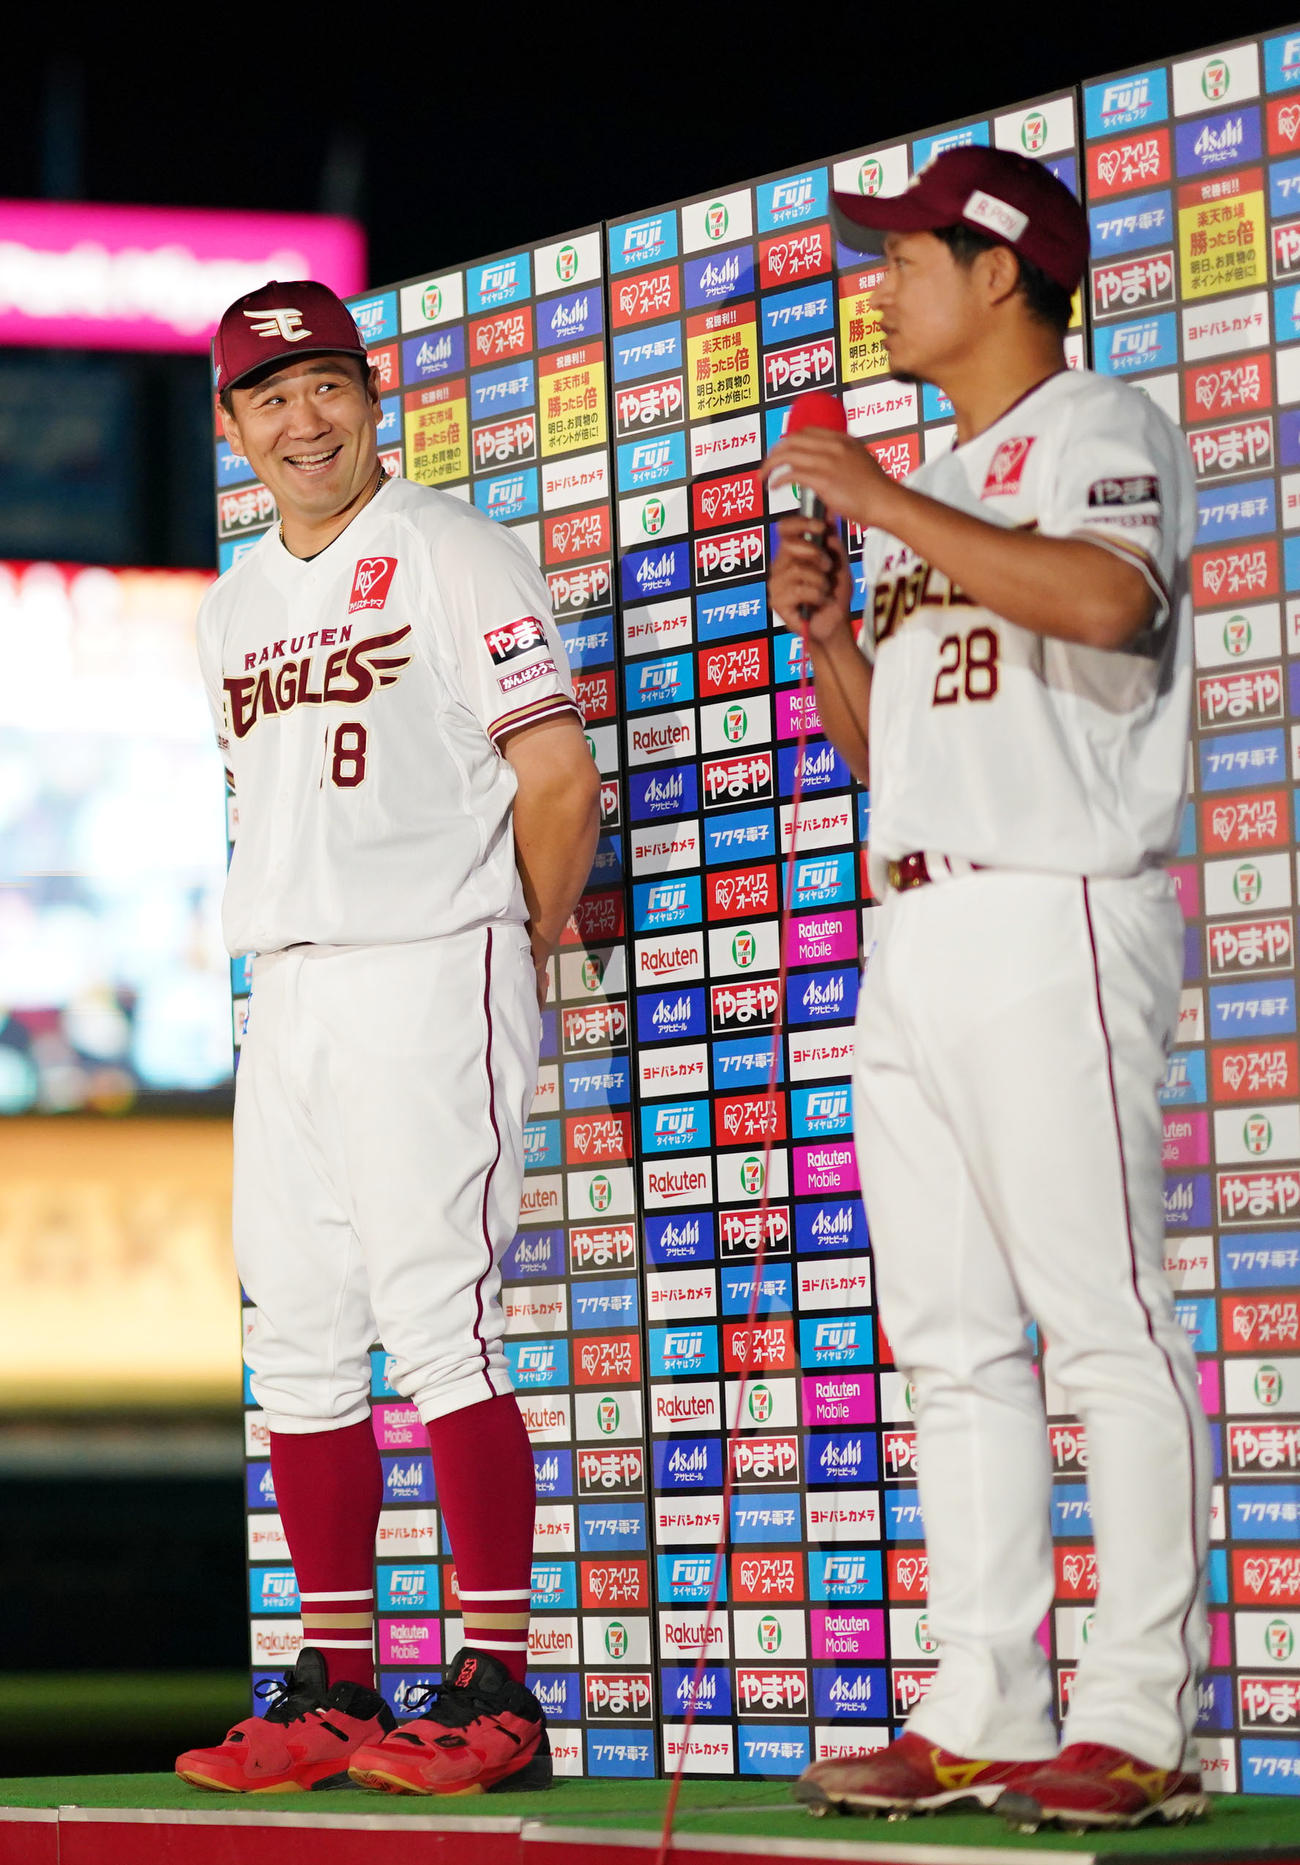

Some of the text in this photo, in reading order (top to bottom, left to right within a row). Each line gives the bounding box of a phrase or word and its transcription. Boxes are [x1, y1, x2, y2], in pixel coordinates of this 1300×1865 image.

[1102, 79, 1151, 117] Fuji
[1194, 118, 1241, 155] Asahi
[1120, 140, 1158, 164] アイリス
[1121, 158, 1158, 182] オーヤマ
[772, 177, 814, 213] Fuji
[1095, 209, 1164, 239] フクダ電子
[624, 220, 664, 254] Fuji
[788, 234, 821, 257] アイリス
[699, 255, 738, 289] Asahi
[789, 251, 821, 274] オーヤマ
[639, 275, 670, 297] アイリス
[1096, 260, 1170, 308] やまや
[551, 297, 587, 329] Asahi
[640, 291, 670, 314] オーヤマ
[766, 299, 826, 327] フクダ電子
[494, 316, 523, 337] アイリス
[1188, 313, 1261, 339] ヨドバシカメラ
[416, 335, 450, 366] Asahi
[495, 332, 524, 353] オーヤマ
[619, 338, 675, 365] フクダ電子
[1112, 322, 1160, 358] Fuji
[767, 346, 831, 391] やまや
[1220, 364, 1258, 388] アイリス
[475, 377, 528, 403] フクダ電子
[1220, 383, 1259, 407] オーヤマ
[619, 384, 680, 427] やまや
[847, 394, 911, 420] ヨドバシカメラ
[476, 422, 533, 464] やまや
[695, 431, 755, 456] ヨドバシカメラ
[632, 440, 672, 473] Fuji
[488, 476, 525, 508] Fuji
[546, 468, 603, 492] ヨドバシカメラ
[721, 478, 753, 500] アイリス
[721, 495, 753, 516] オーヤマ
[571, 514, 601, 535] アイリス
[572, 530, 601, 551] オーヤマ
[636, 551, 674, 582] Asahi
[698, 533, 761, 576] やまや
[550, 568, 609, 609] やまや
[702, 599, 760, 623] フクダ電子
[628, 615, 687, 637] ヨドバシカメラ
[244, 624, 353, 671] RAKUTEN
[490, 620, 549, 659] やま
[640, 661, 680, 692] Fuji
[933, 627, 998, 707] 28
[223, 625, 414, 741] EAGLES
[1202, 674, 1278, 719] やまや
[633, 725, 689, 749] Rakuten
[320, 722, 368, 789] 8
[644, 773, 682, 802] Asahi
[707, 759, 769, 799] やまや
[635, 838, 695, 857] ヨドバシカメラ
[710, 825, 769, 847] フクダ電子
[735, 873, 768, 892] アイリス
[798, 860, 841, 892] Fuji
[648, 883, 688, 913] Fuji
[736, 890, 768, 909] オーヤマ
[798, 919, 842, 937] Rakuten
[799, 941, 831, 958] Mobile
[1212, 924, 1289, 967] やまや
[641, 947, 698, 970] Rakuten
[803, 976, 843, 1005] Asahi
[652, 996, 690, 1024] Asahi
[566, 1008, 625, 1046] やまや
[569, 1073, 624, 1093] フクダ電子
[643, 1062, 703, 1079] ヨドバシカメラ
[807, 1150, 851, 1167] Rakuten
[649, 1171, 706, 1193] Rakuten
[808, 1171, 840, 1187] Mobile
[1222, 1175, 1299, 1216] やまや
[811, 1208, 852, 1235] Asahi
[514, 1238, 550, 1263] Asahi
[573, 1231, 633, 1267] やまや
[802, 1277, 866, 1292] ヨドバシカメラ
[506, 1303, 562, 1317] ヨドバシカメラ
[576, 1296, 633, 1314] フクダ電子
[601, 1344, 631, 1360] アイリス
[664, 1333, 705, 1360] Fuji
[601, 1360, 632, 1377] オーヤマ
[657, 1396, 714, 1417] Rakuten
[668, 1447, 707, 1472] Asahi
[732, 1444, 795, 1479] やまや
[659, 1515, 720, 1527] ヨドバシカメラ
[735, 1511, 795, 1528] フクダ電子
[811, 1511, 875, 1524] ヨドバシカメラ
[761, 1560, 793, 1576] アイリス
[824, 1557, 868, 1584] Fuji
[761, 1577, 794, 1593] オーヤマ
[825, 1615, 869, 1631] Rakuten
[826, 1637, 858, 1652] Mobile
[589, 1680, 650, 1714] やまや
[740, 1675, 804, 1709] やまや
[829, 1676, 870, 1700] Asahi
[592, 1746, 649, 1762] フクダ電子
